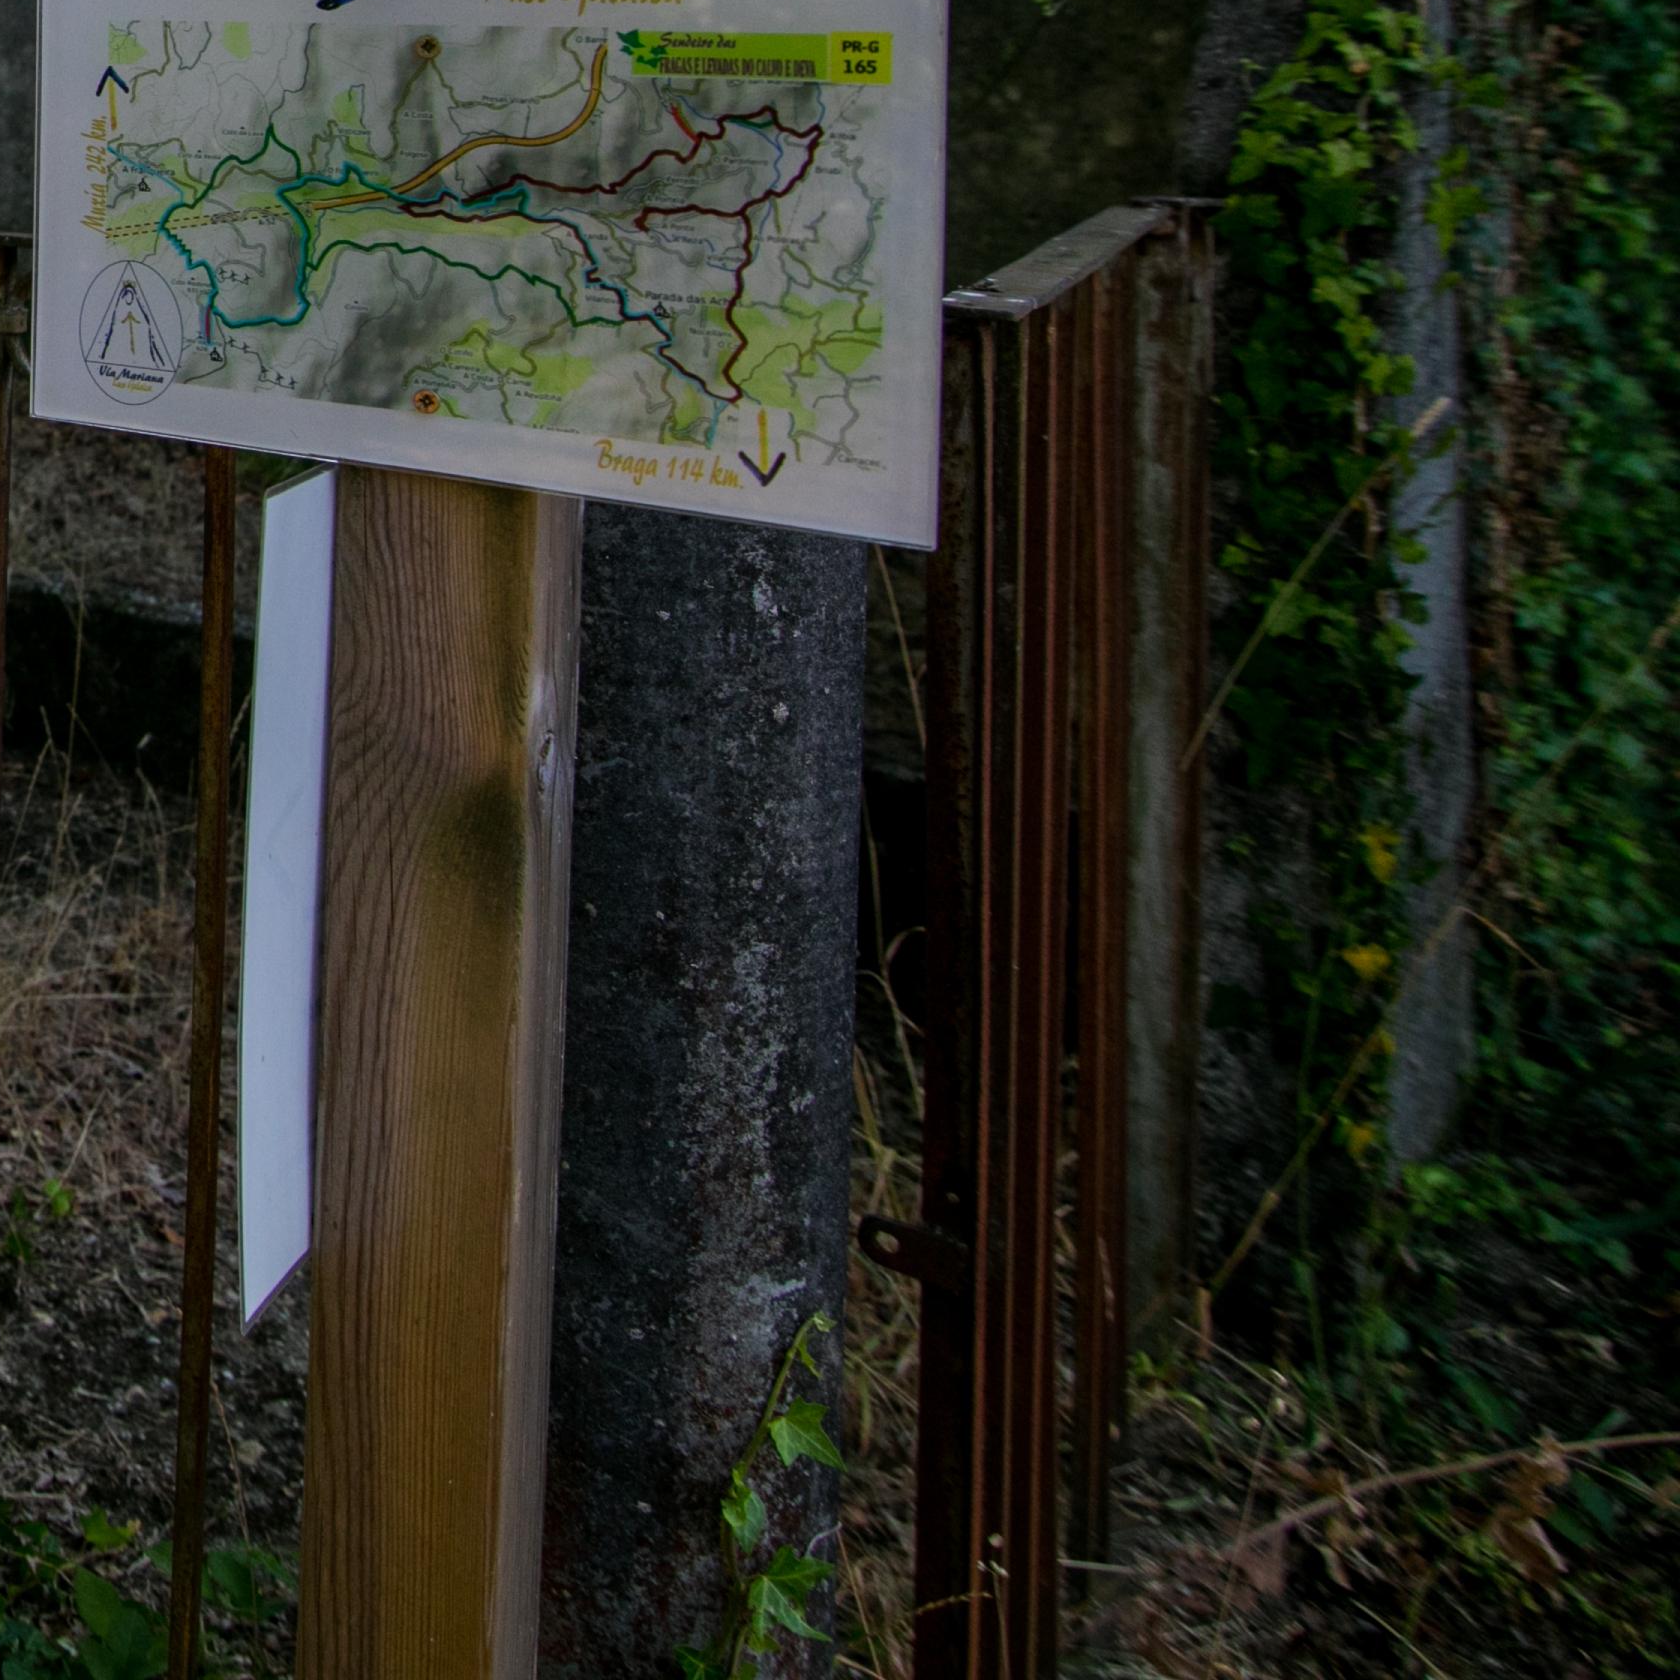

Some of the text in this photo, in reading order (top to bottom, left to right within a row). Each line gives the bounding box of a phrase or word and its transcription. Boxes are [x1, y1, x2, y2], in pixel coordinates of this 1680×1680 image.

[659, 31, 737, 49] Sendeiro das
[841, 40, 881, 54] PR-G
[843, 59, 878, 75] 165
[84, 144, 107, 175] 242
[645, 290, 683, 303] Parada
[686, 294, 706, 304] das
[115, 368, 164, 384] Mariana
[593, 438, 744, 490] Braga 114 km.
